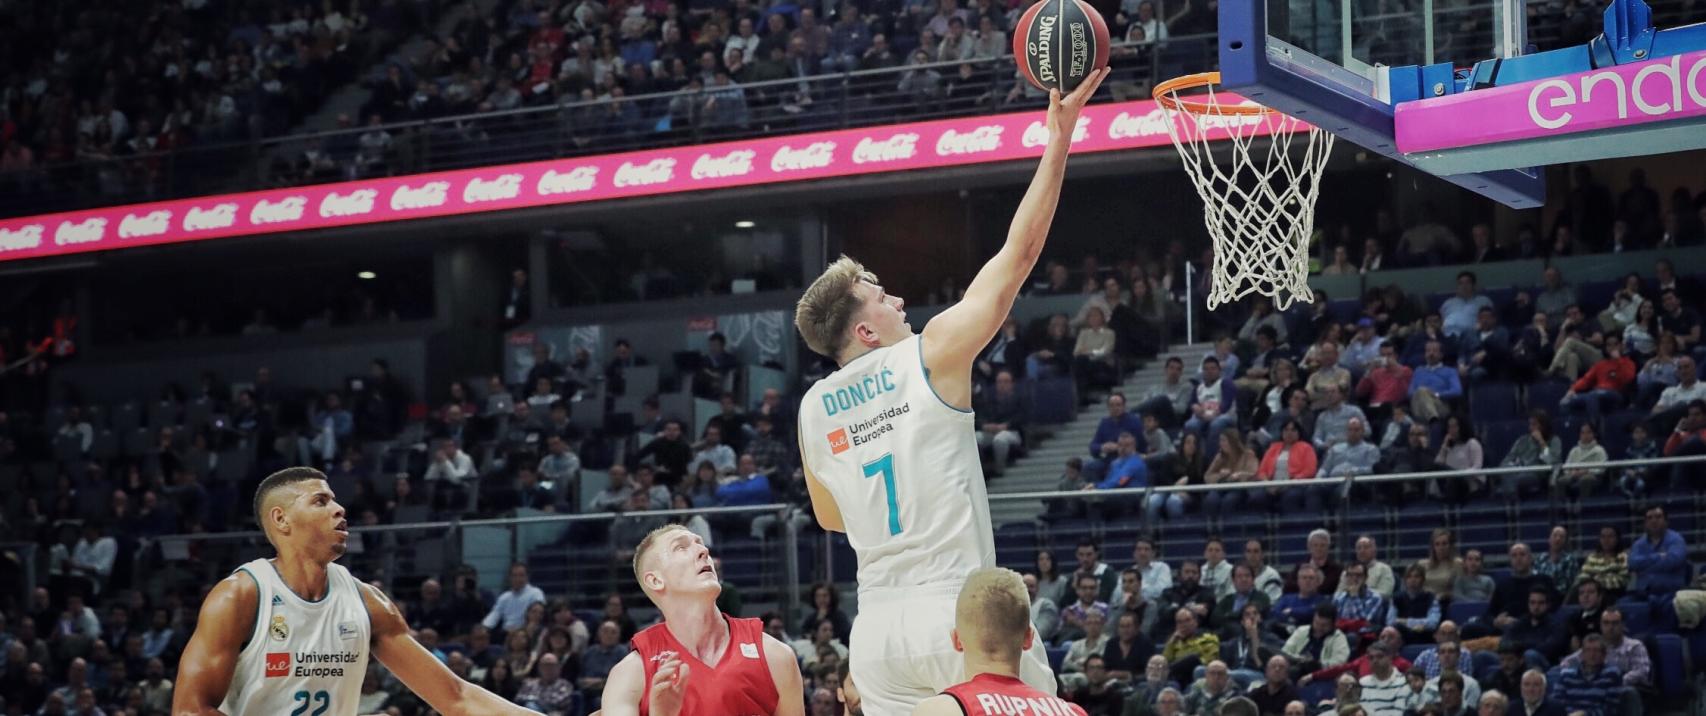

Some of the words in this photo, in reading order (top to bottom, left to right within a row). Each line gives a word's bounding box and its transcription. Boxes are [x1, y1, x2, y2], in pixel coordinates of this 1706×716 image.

[1039, 15, 1058, 82] SPALDING
[822, 366, 896, 416] DONČIĆ
[849, 402, 910, 434] Universidad
[853, 423, 893, 446] Europea
[862, 452, 904, 536] 7
[295, 667, 344, 678] Europea
[291, 690, 330, 716] 22
